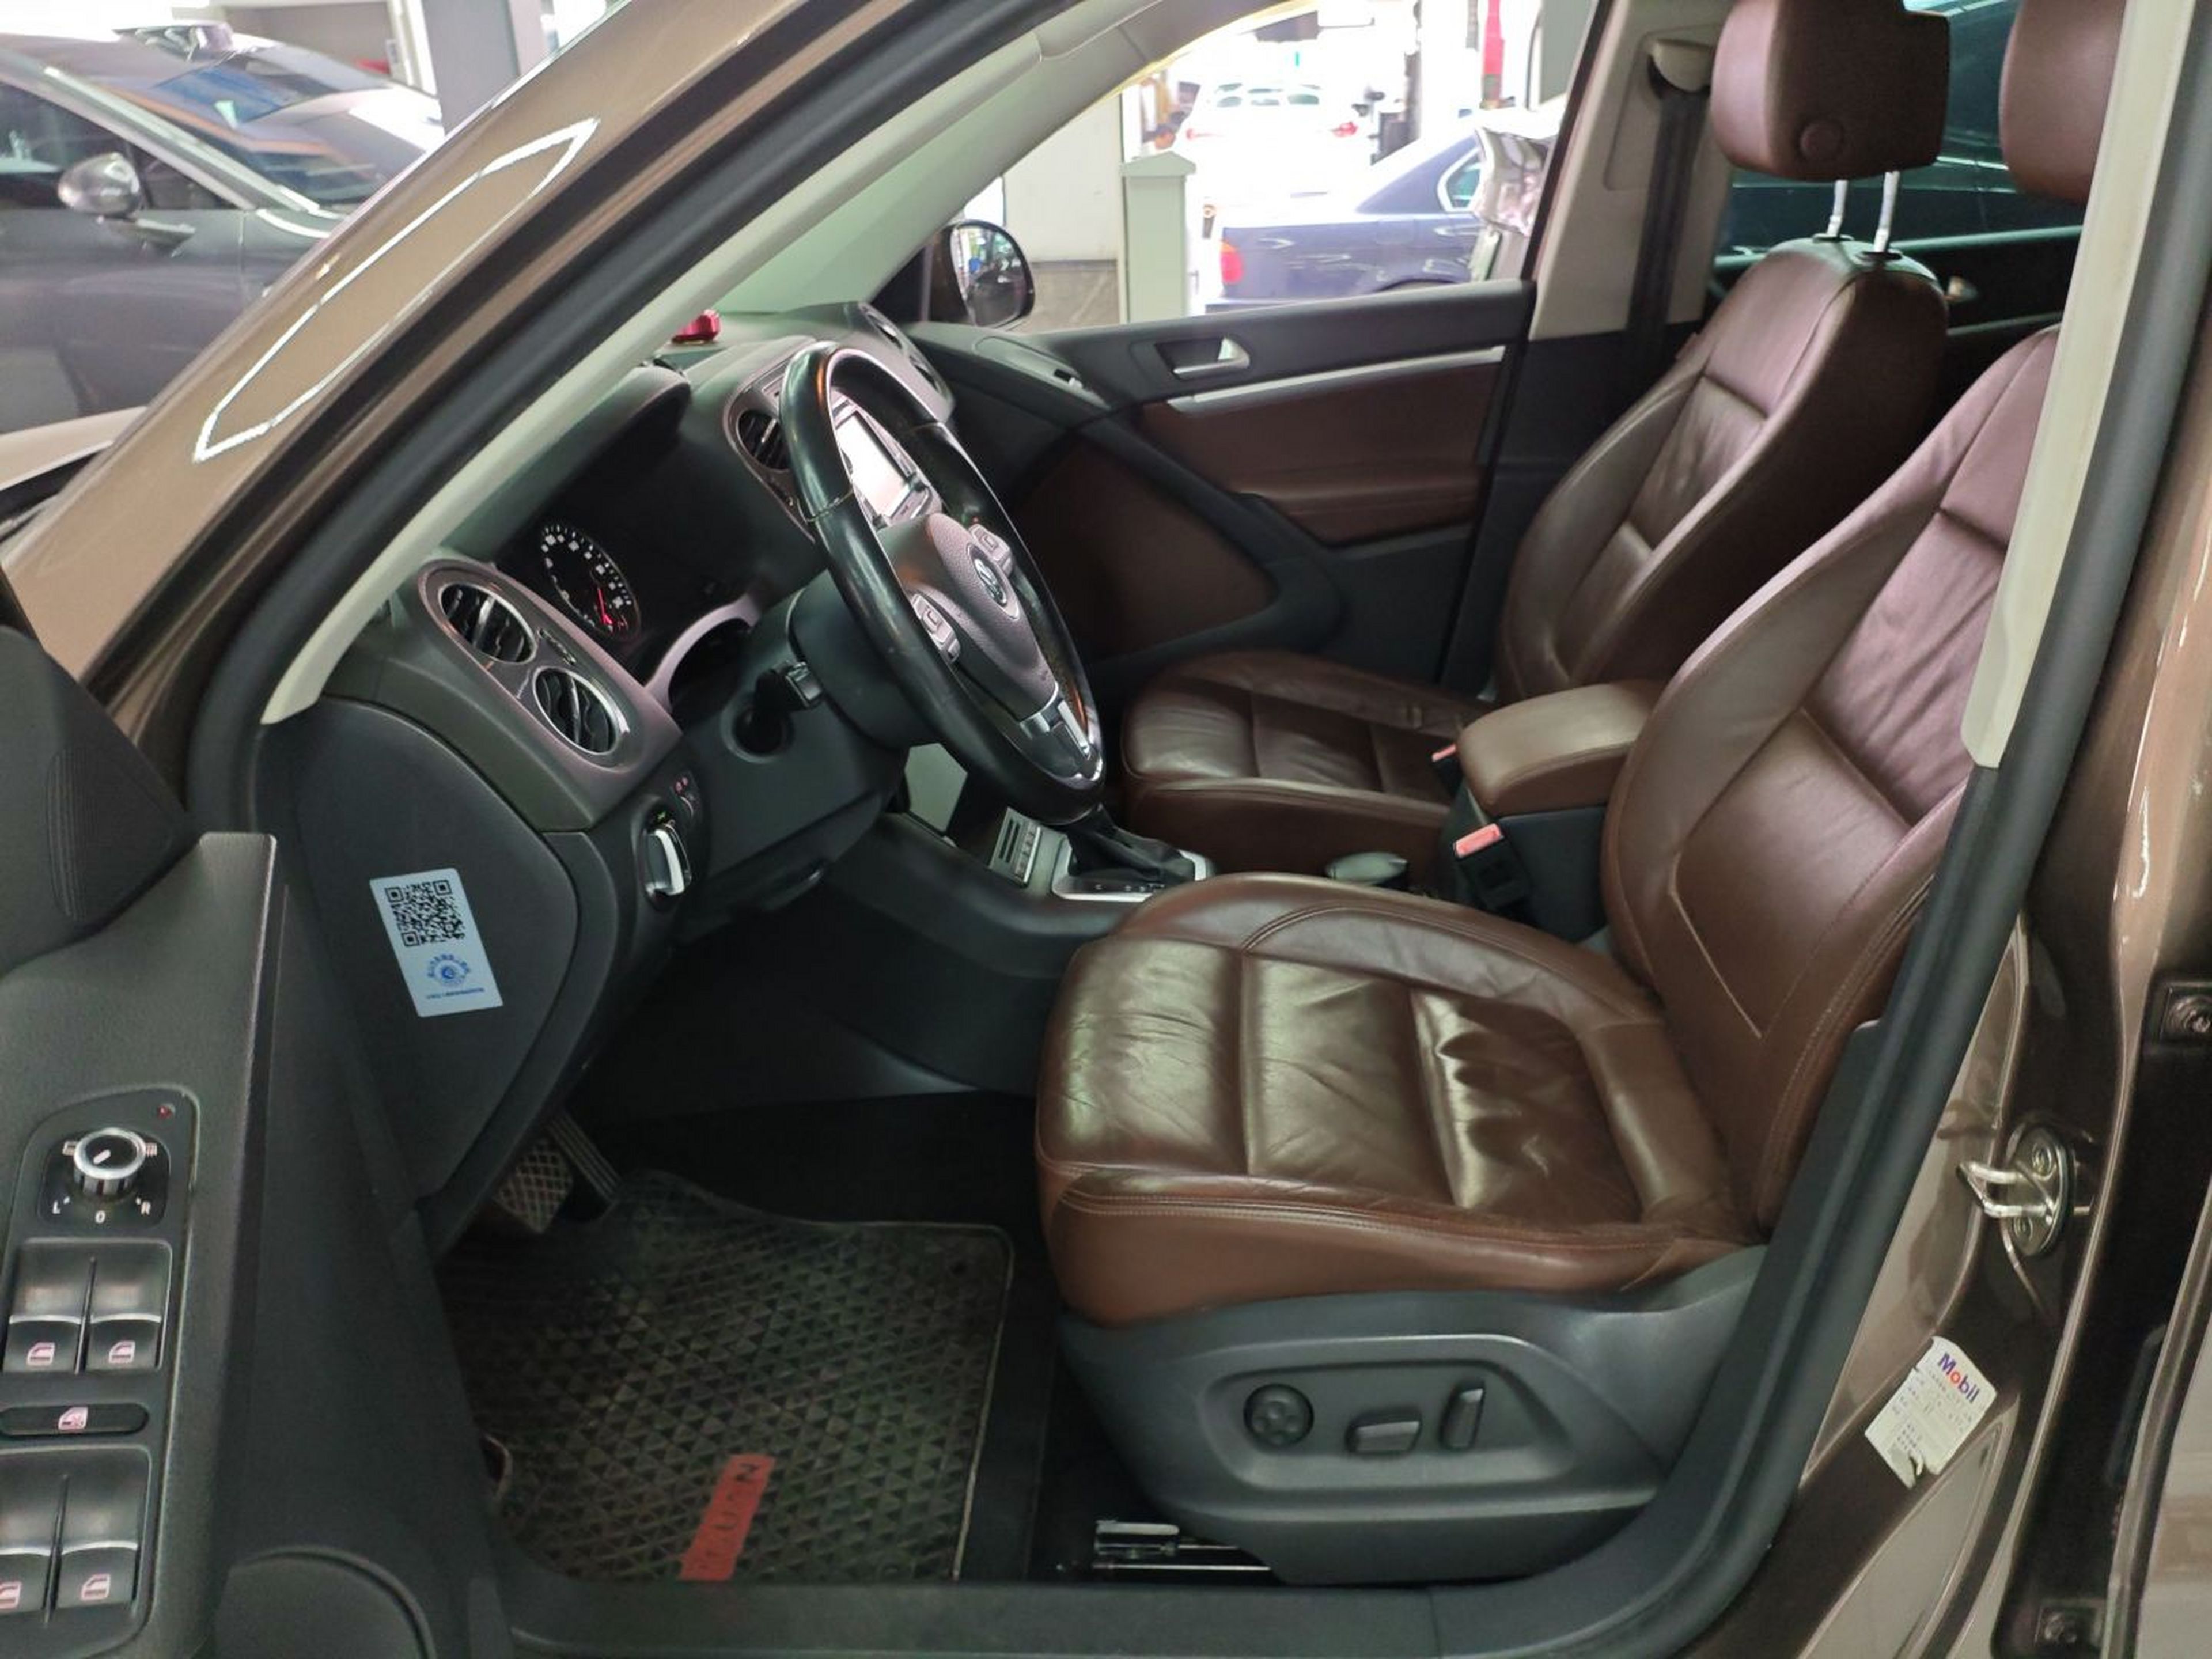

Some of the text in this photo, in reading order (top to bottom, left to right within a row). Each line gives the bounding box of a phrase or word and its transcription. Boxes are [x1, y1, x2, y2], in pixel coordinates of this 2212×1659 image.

[52, 1201, 60, 1214] L
[141, 1201, 151, 1215] R
[1937, 1352, 1980, 1403] Mobil
